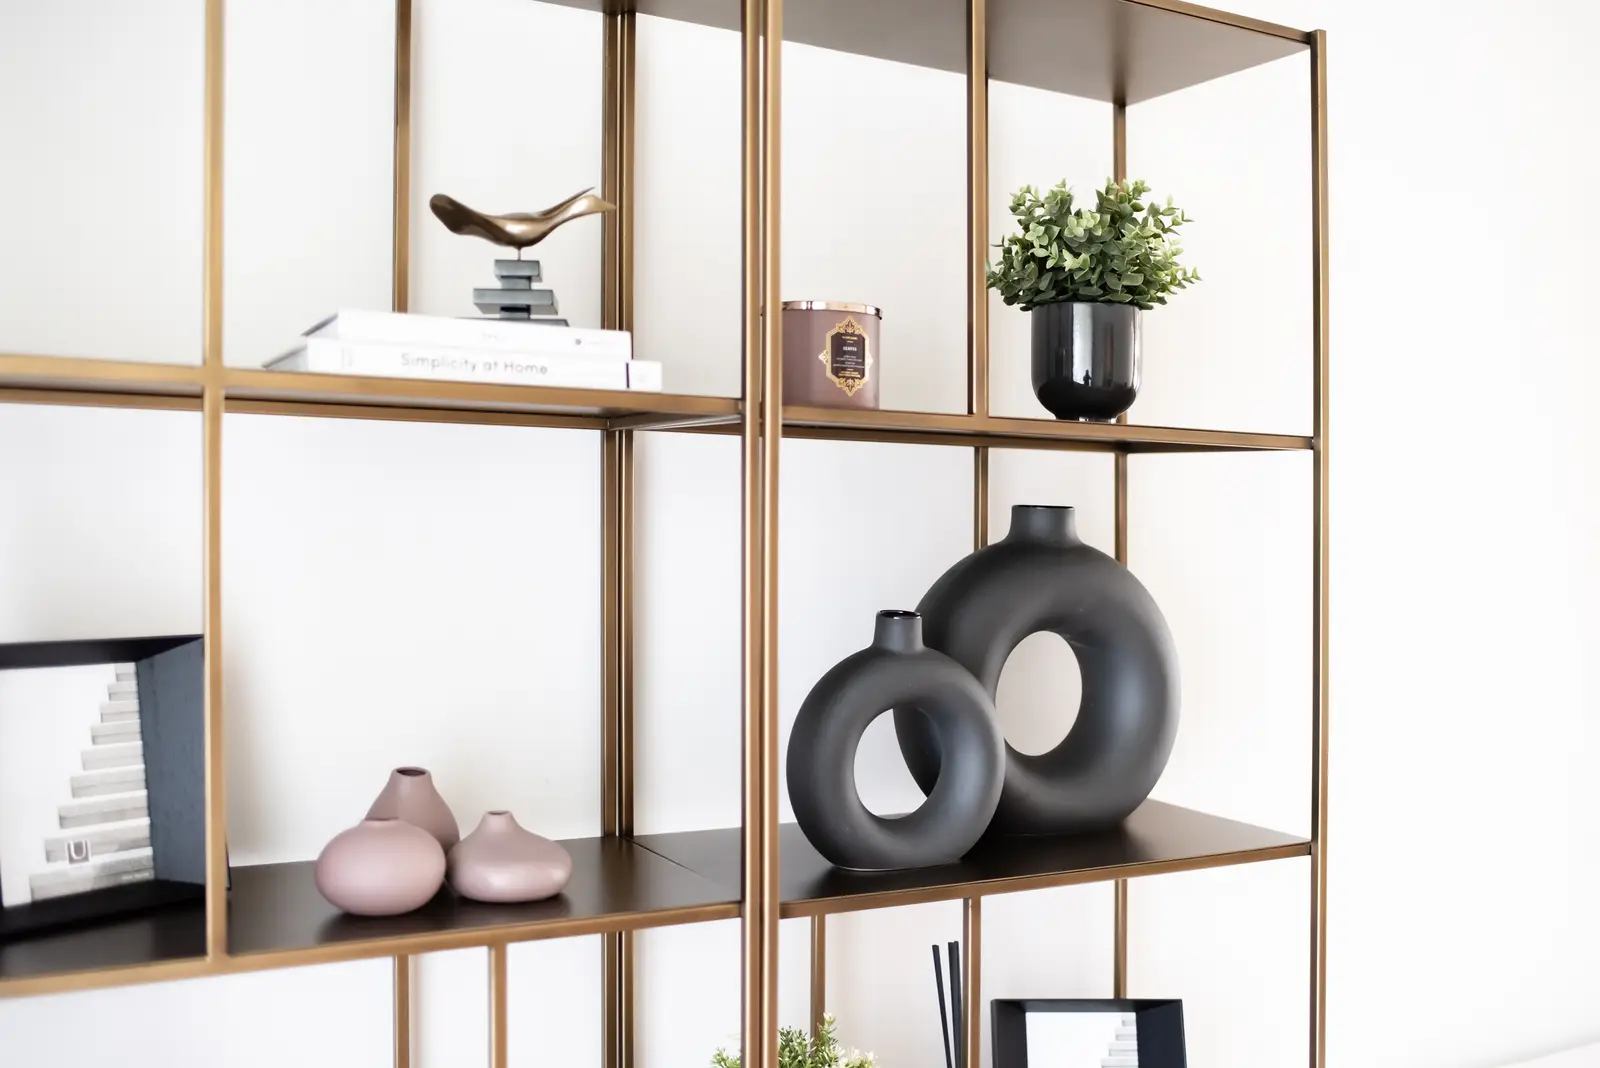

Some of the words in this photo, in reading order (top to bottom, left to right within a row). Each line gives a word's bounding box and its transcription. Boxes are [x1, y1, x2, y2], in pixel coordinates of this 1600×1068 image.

[401, 352, 476, 372] Simplicity
[483, 360, 498, 371] at
[504, 361, 548, 375] Home
